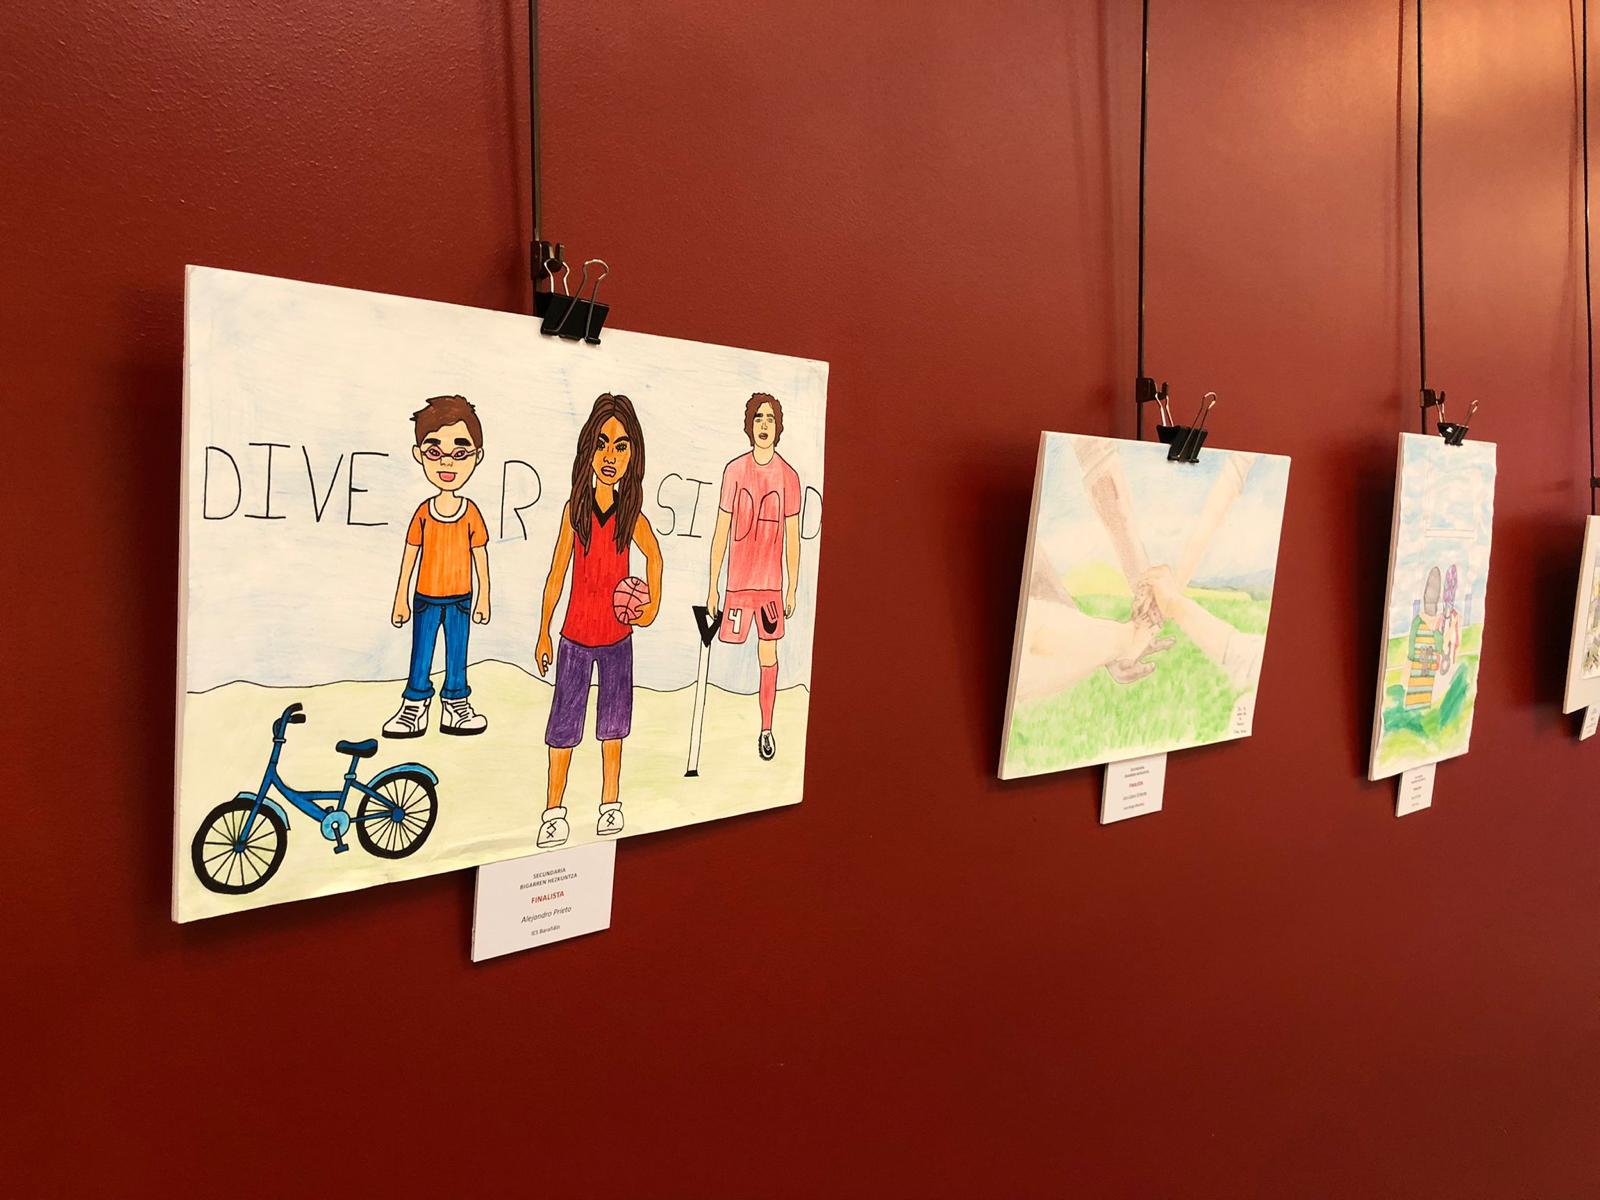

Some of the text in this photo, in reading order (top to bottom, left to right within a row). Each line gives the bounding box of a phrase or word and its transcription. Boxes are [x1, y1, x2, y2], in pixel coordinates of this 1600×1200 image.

[727, 608, 743, 635] 4
[519, 872, 577, 889] BIGARREN HEZKUNTZA
[533, 867, 565, 879] SECUNDARIA
[531, 890, 565, 904] FINALISTA
[521, 906, 572, 923] Alejandro Prieto
